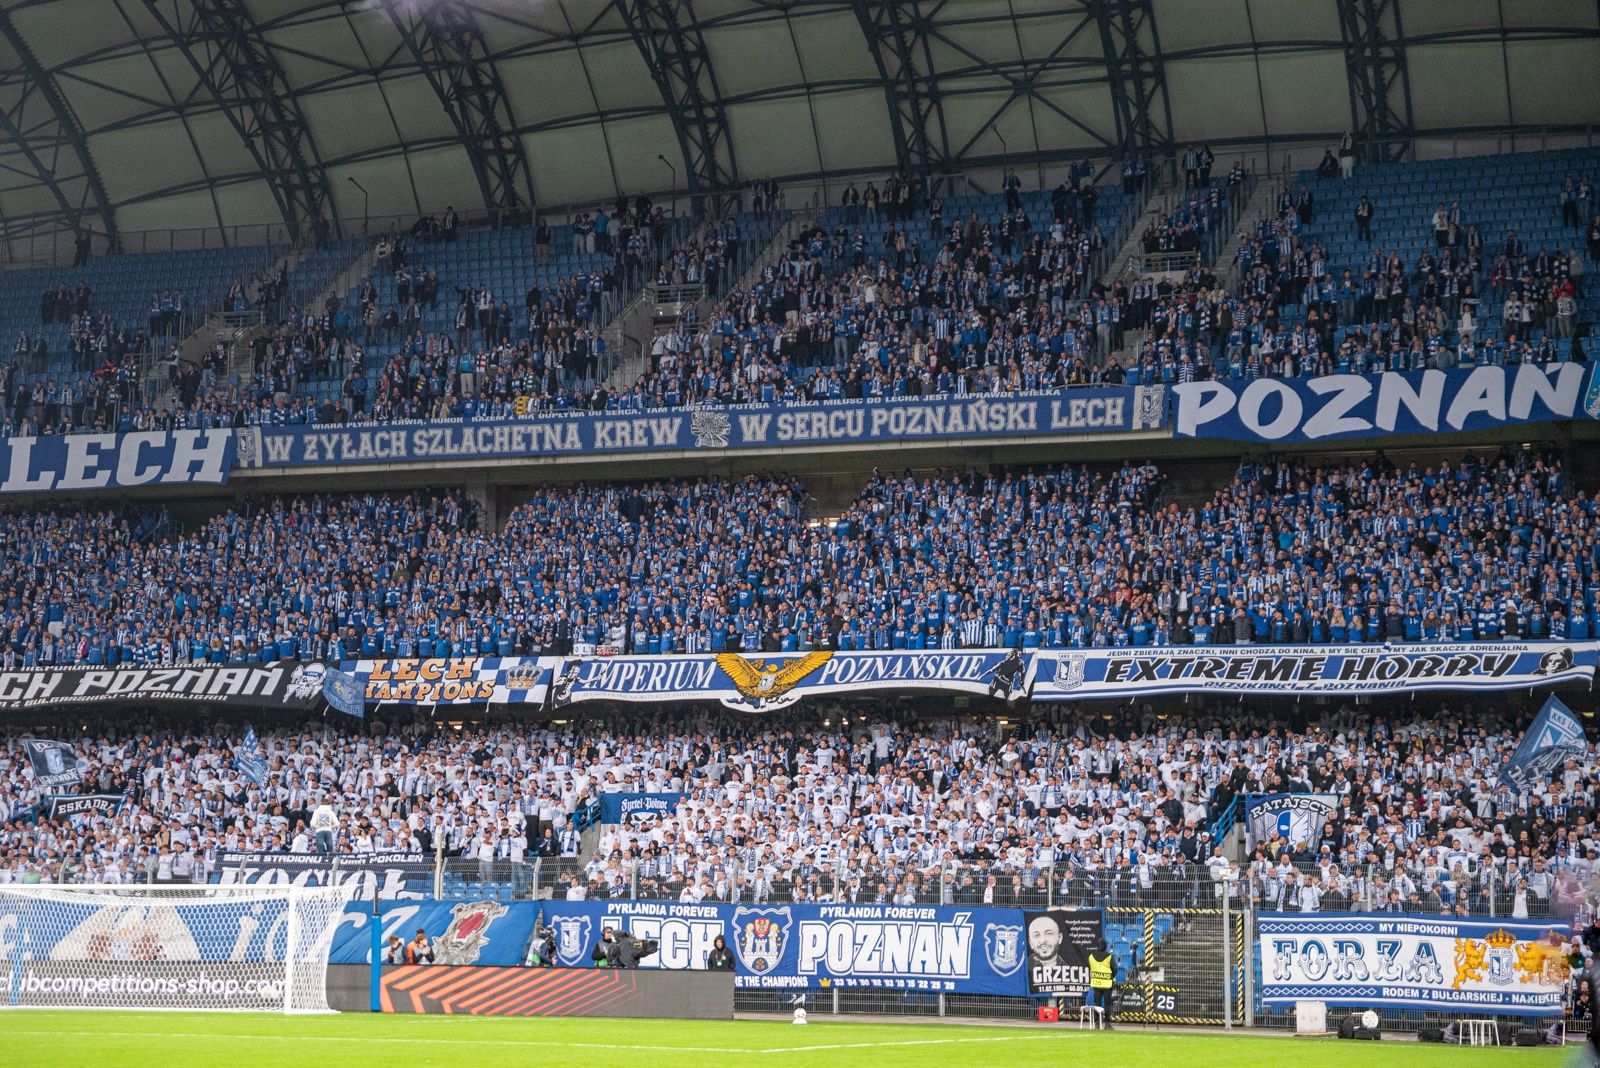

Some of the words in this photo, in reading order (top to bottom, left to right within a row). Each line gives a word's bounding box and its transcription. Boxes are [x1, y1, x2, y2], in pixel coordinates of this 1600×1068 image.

[923, 393, 949, 402] JEST
[1172, 362, 1586, 439] POZNAŃ
[263, 434, 294, 462] W
[412, 422, 582, 457] SZLACHETNA
[593, 416, 683, 448] KREW
[738, 413, 772, 443] W
[776, 407, 865, 440] SERCU
[871, 398, 1037, 436] POZNAŃSKI
[1050, 396, 1125, 430] LECH
[1, 428, 232, 492] LECH
[1133, 649, 1175, 657] ZBIERAJĄ
[1361, 645, 1407, 654] CIESYMY
[1409, 645, 1428, 653] JAK
[1469, 644, 1529, 652] ADRENALINA
[73, 661, 284, 695] POZNAŃ
[367, 657, 479, 681] LECH
[582, 660, 718, 692] IMPERIUM
[816, 653, 987, 684] POZNAŃSKIE
[1103, 656, 1326, 683] EXTREME
[1338, 653, 1521, 681] HOBBY
[1250, 797, 1333, 820] RATAJSCY
[263, 854, 322, 864] STADIONU
[369, 852, 424, 864] POKOLEŃ
[607, 903, 666, 916] PYRLANDIA
[670, 904, 718, 918] FOREVER
[820, 907, 882, 918] PYRLANDIA
[884, 907, 936, 920] FOREVER
[1379, 923, 1395, 932] MY
[1397, 923, 1458, 936] NIEPOKORNI
[798, 911, 975, 979] POZNAŃ
[1272, 937, 1444, 985] FORZA
[0, 970, 288, 1000] clbcompetitions-shop.com
[744, 976, 760, 987] THE
[761, 976, 809, 988] CHAMPIONS
[1033, 965, 1089, 984] GRZECH
[1157, 995, 1175, 1010] 25
[1383, 987, 1420, 999] RODEM
[1422, 989, 1431, 999] Z
[1432, 989, 1502, 1003] BUŁGARSKIEJ
